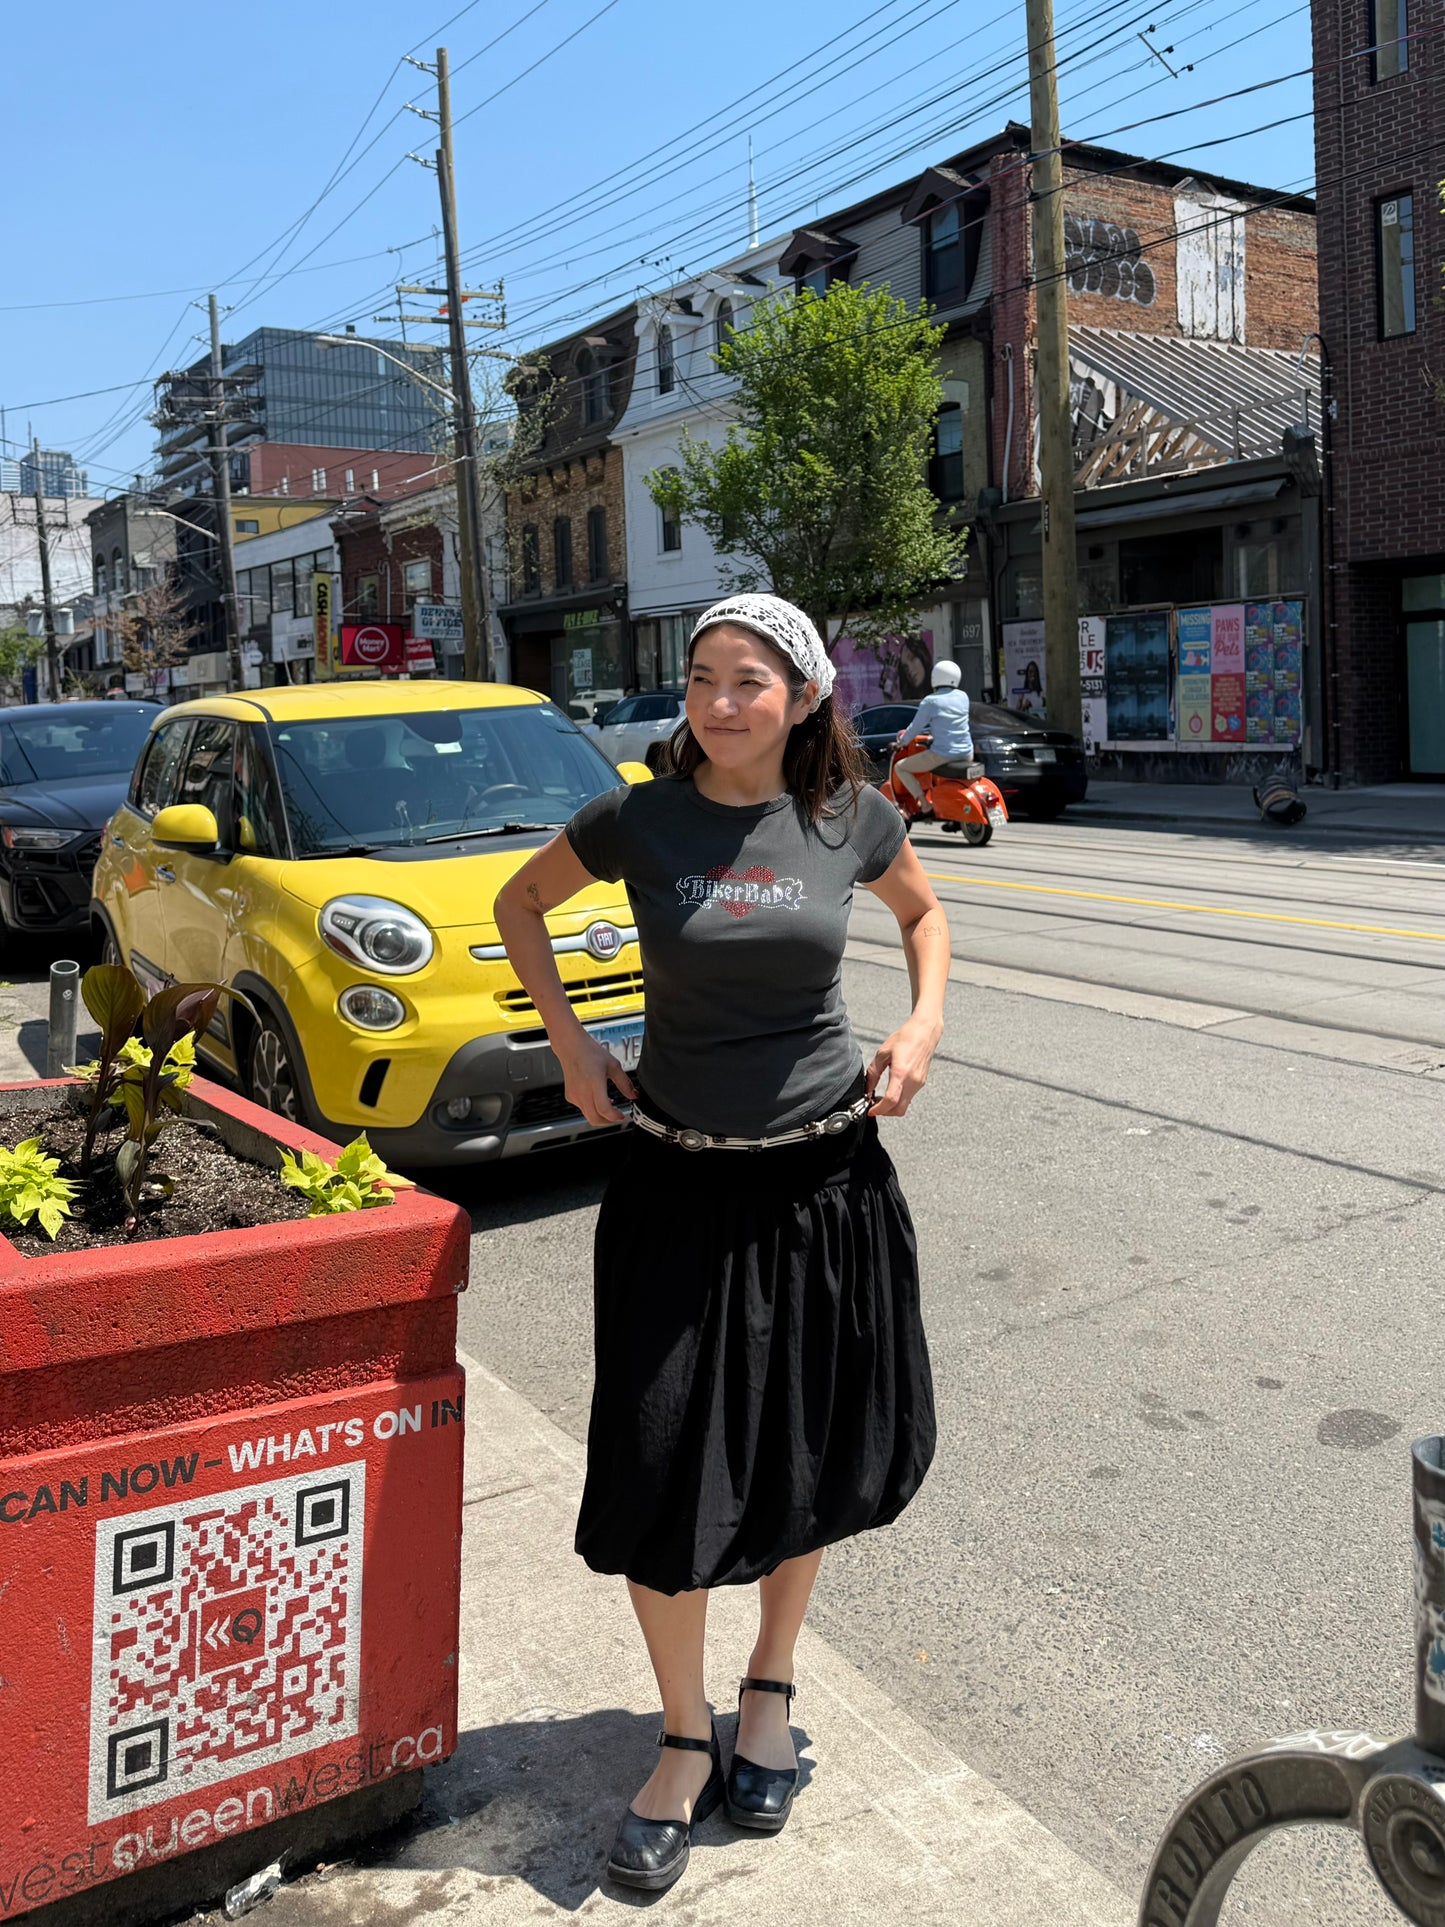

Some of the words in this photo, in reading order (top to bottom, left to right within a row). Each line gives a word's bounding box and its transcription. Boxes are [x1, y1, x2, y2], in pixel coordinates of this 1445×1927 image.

[317, 583, 328, 615] CASH
[1181, 613, 1211, 625] MISSING
[1215, 617, 1239, 633] PAWS
[962, 624, 981, 639] 697
[359, 637, 385, 646] Money
[1080, 634, 1096, 648] LE
[1214, 640, 1240, 656] Pets
[1080, 680, 1103, 691] -5131
[596, 932, 614, 947] FIAT
[100, 1451, 200, 1503] NOW
[228, 1415, 364, 1473] WHAT'S
[373, 1404, 422, 1440] ON
[431, 1395, 462, 1429] IN
[1148, 1772, 1271, 1927] RONTO
